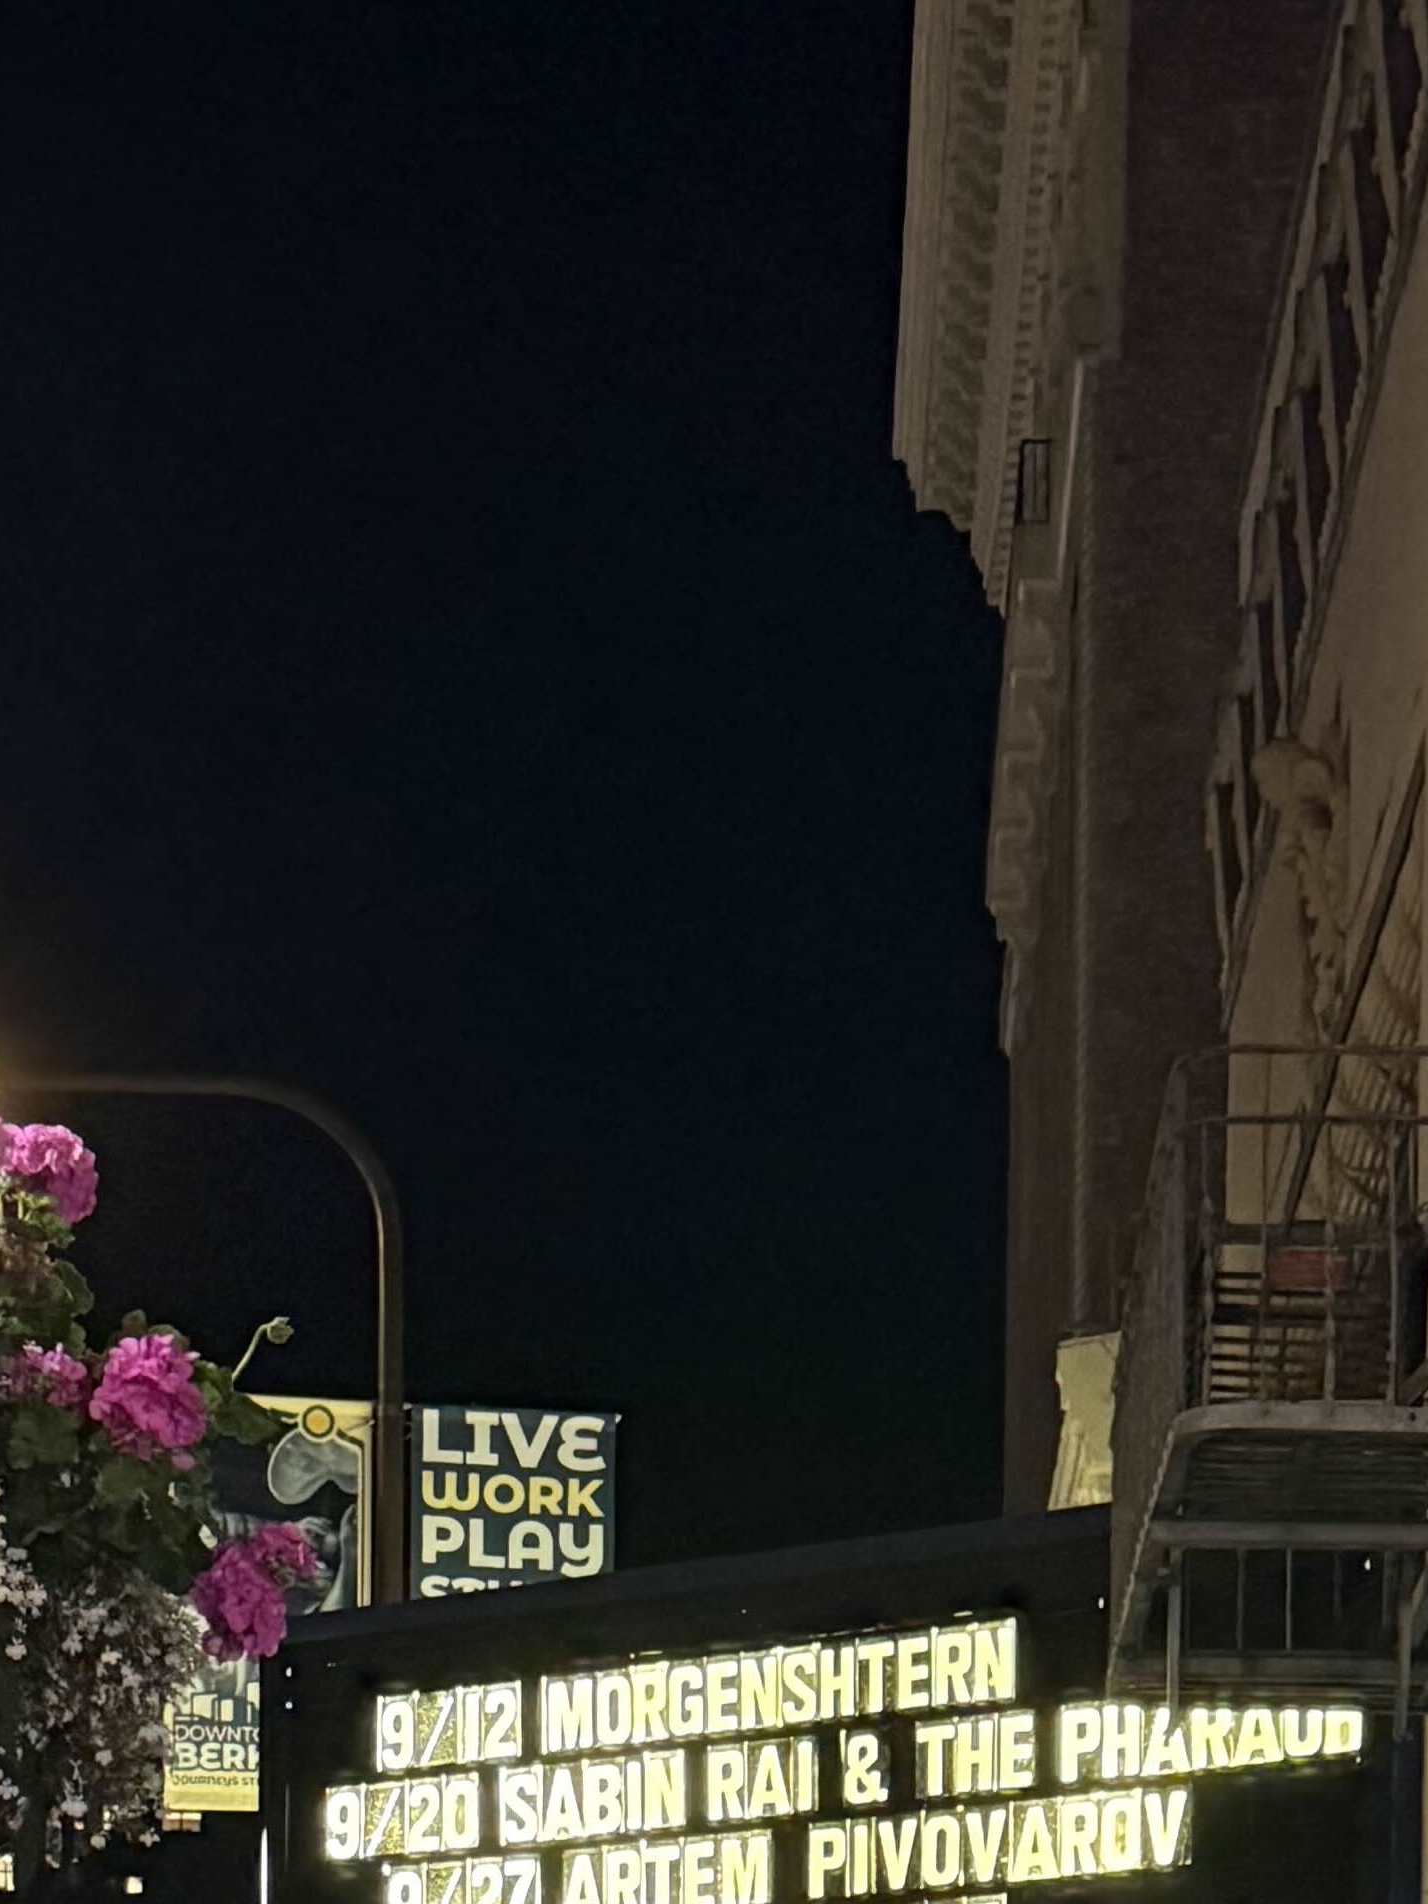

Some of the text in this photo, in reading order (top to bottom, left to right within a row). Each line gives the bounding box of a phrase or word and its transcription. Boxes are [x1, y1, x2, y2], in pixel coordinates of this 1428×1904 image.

[423, 1408, 606, 1472] LIVE
[422, 1470, 605, 1517] WORK
[422, 1514, 604, 1578] PLAY
[380, 1624, 1015, 1770] 9/12 MORGENSHTERN
[327, 1780, 478, 1858] 9/20
[502, 1755, 684, 1843] SABIN
[708, 1741, 813, 1819] RAI
[844, 1733, 888, 1804] &
[916, 1715, 1033, 1796] THE
[810, 1791, 1188, 1898] PIVOVAROV
